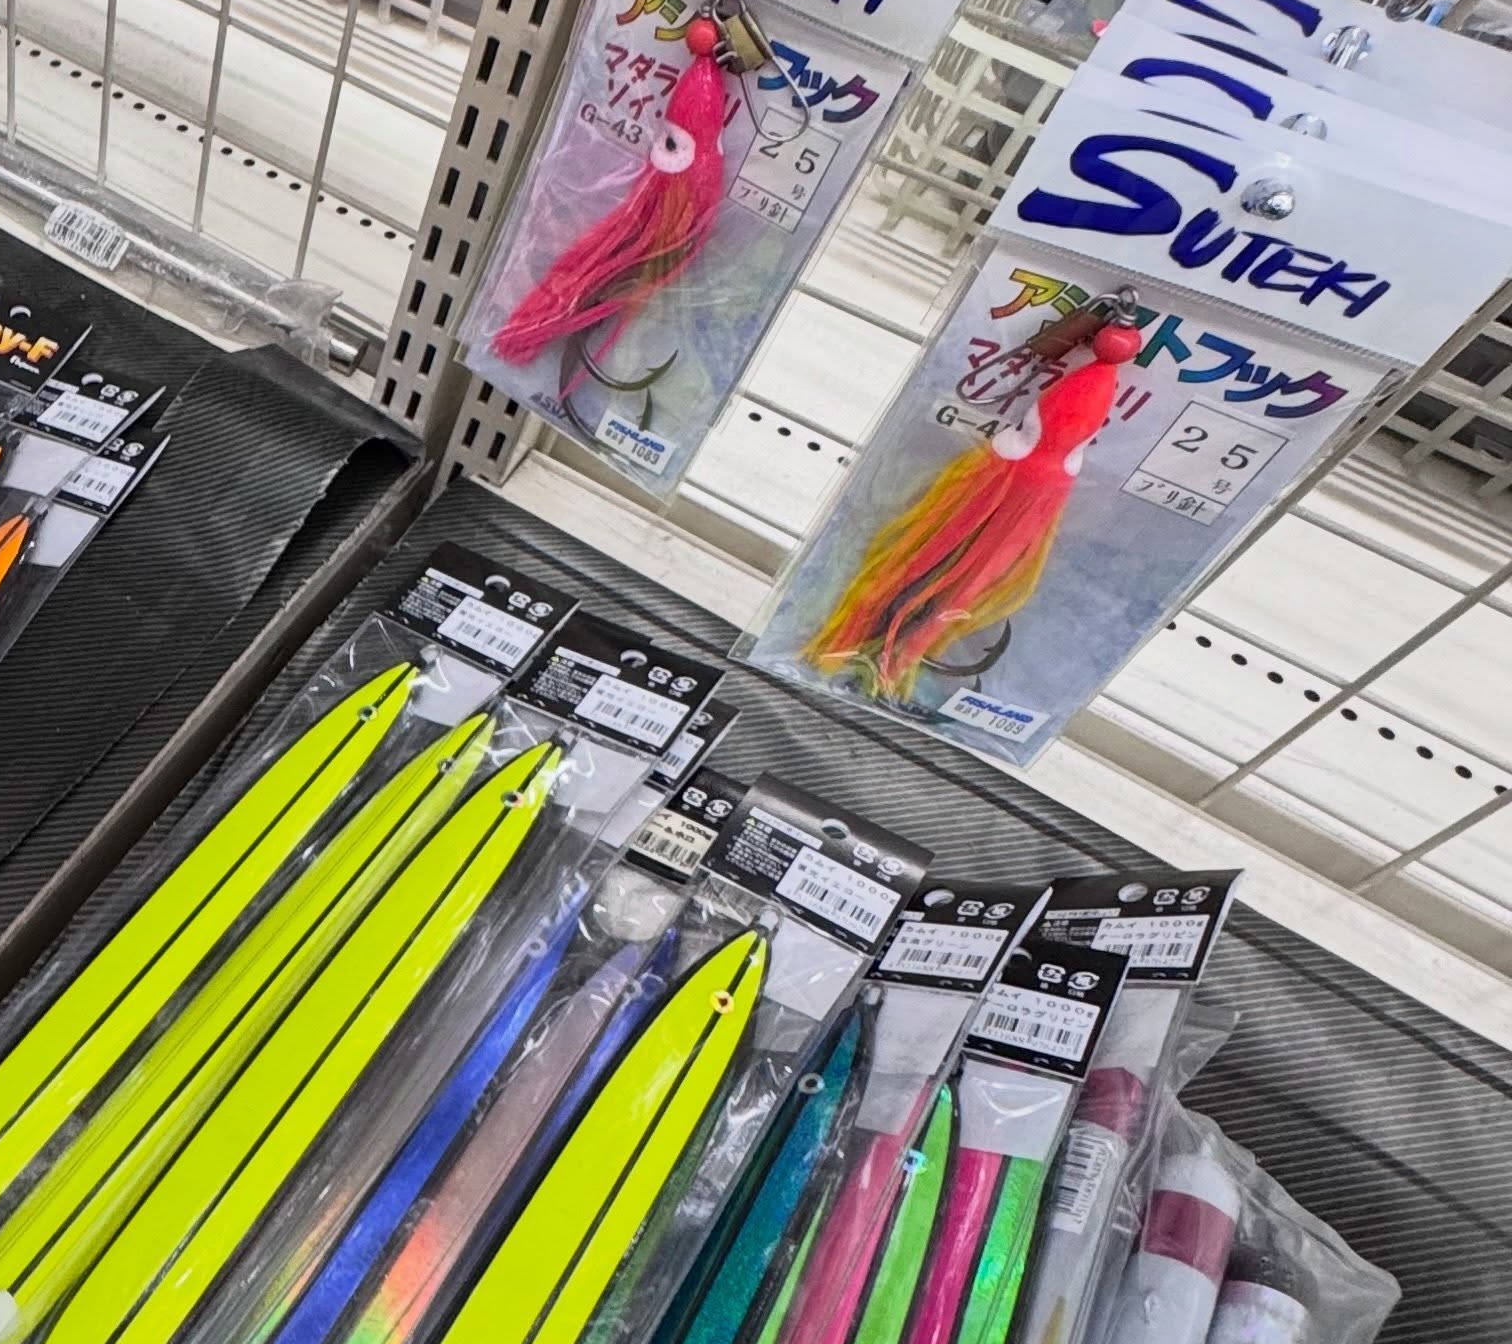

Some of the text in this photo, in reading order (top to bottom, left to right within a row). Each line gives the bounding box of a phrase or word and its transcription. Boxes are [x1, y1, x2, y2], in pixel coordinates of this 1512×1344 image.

[604, 41, 681, 98] マダラ
[579, 102, 644, 145] G-43
[1017, 131, 1395, 320] SUTEKI
[608, 419, 666, 453] FISHLAND
[935, 403, 1011, 439] G-4
[959, 694, 1035, 725] FISHLAND
[988, 714, 1026, 736] 1089
